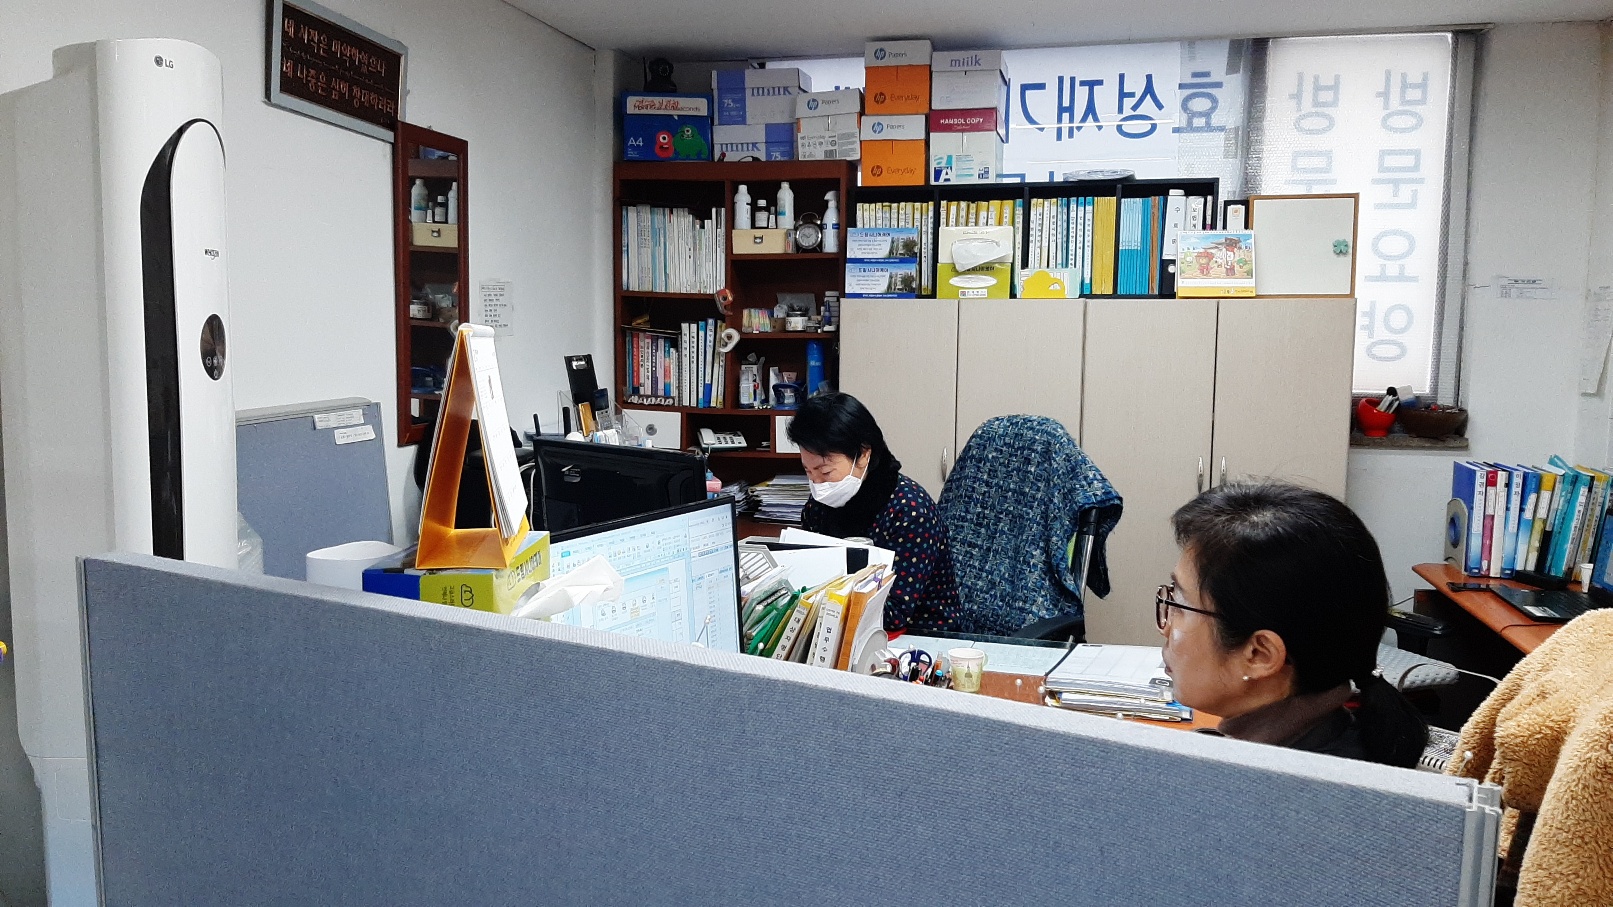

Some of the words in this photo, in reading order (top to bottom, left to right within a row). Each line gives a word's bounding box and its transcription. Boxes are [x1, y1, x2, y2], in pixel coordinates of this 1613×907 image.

[299, 24, 329, 57] 시작은
[874, 48, 886, 60] hp
[297, 63, 327, 96] 나중은
[331, 77, 349, 100] 심히
[352, 84, 397, 116] 창대하리라
[723, 99, 733, 107] 75
[807, 98, 819, 110] hp
[890, 94, 920, 103] Everyday
[872, 122, 884, 134] hp
[628, 137, 643, 147] A4
[871, 165, 883, 177] hp
[887, 166, 916, 175] Everyday
